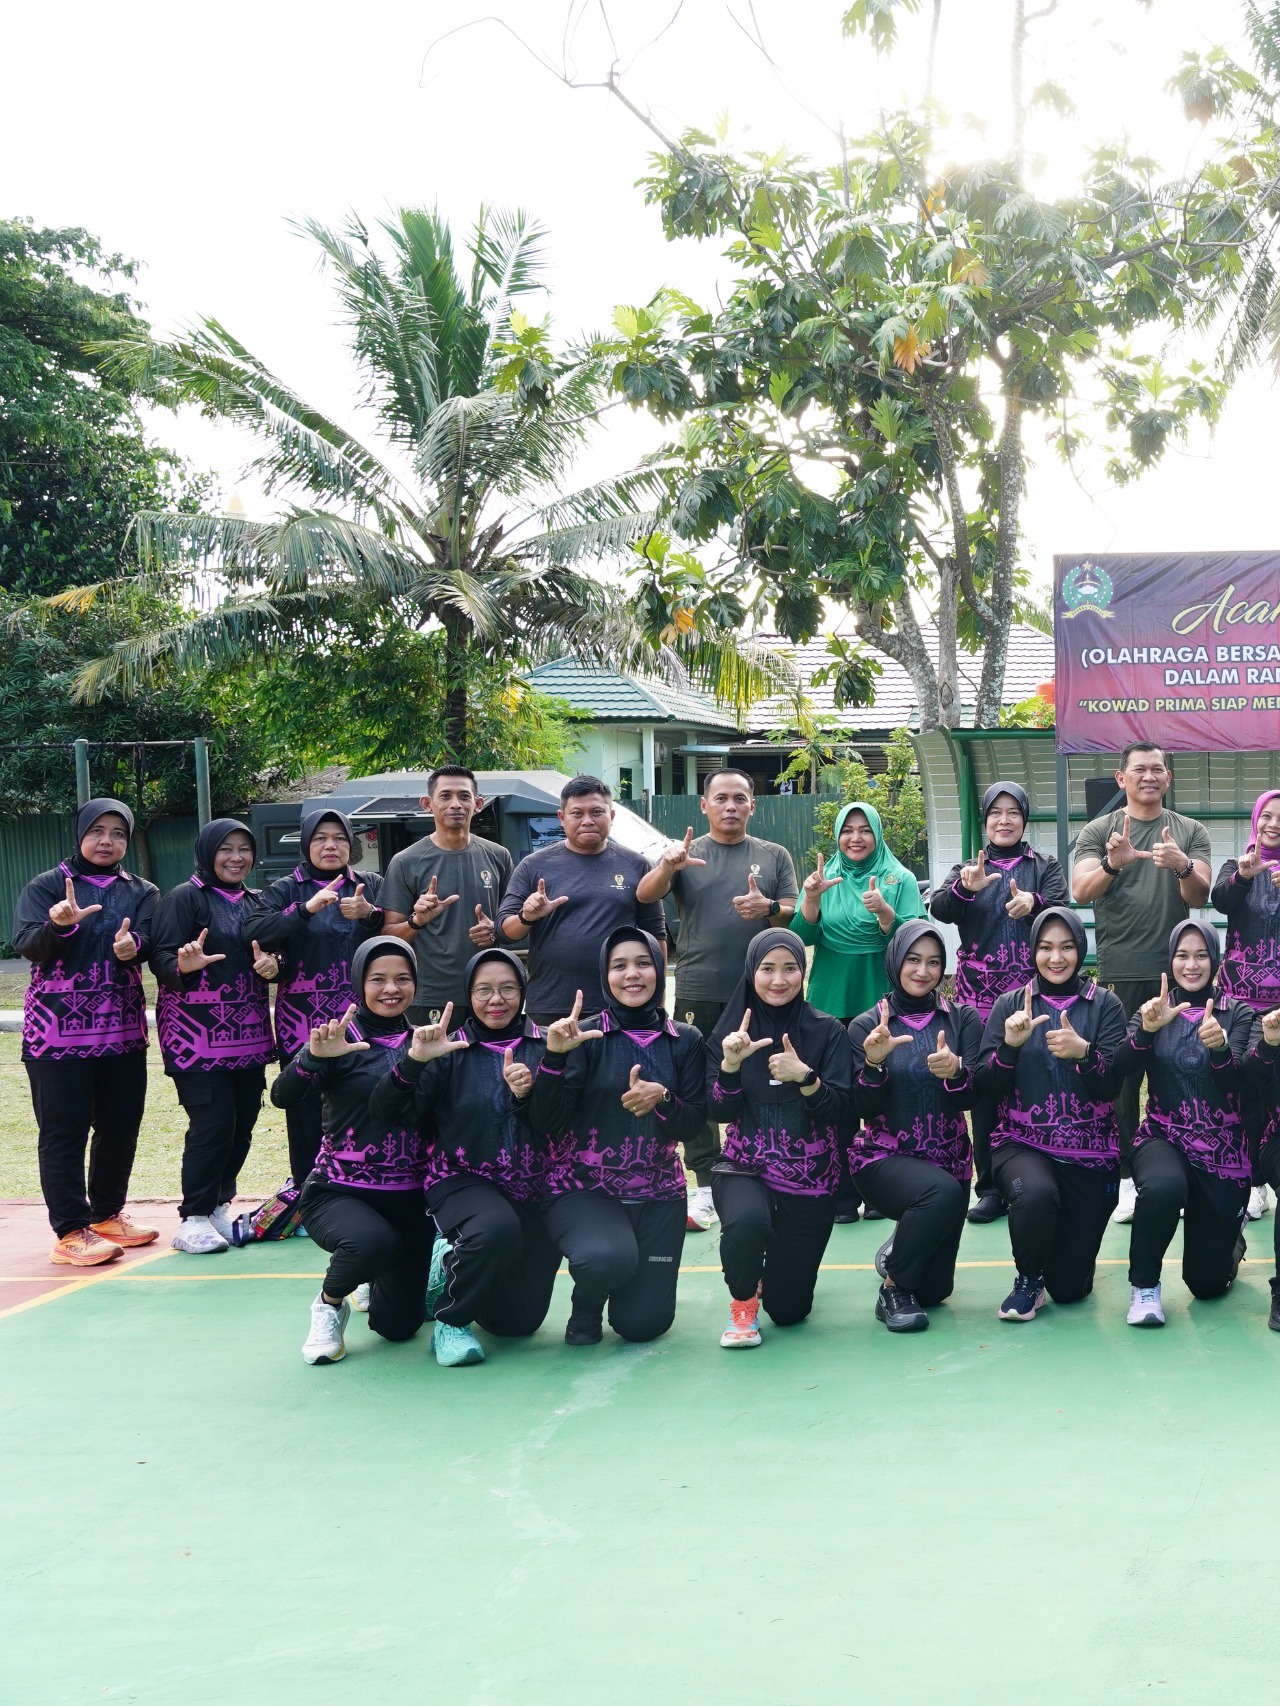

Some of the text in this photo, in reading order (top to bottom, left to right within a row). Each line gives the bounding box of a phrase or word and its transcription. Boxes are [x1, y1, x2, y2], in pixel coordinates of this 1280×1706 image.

[1081, 646, 1210, 668] (OLAHRAGA
[1165, 668, 1240, 686] DALAM
[1155, 698, 1207, 712] PRIMA
[1211, 697, 1247, 710] SIAP
